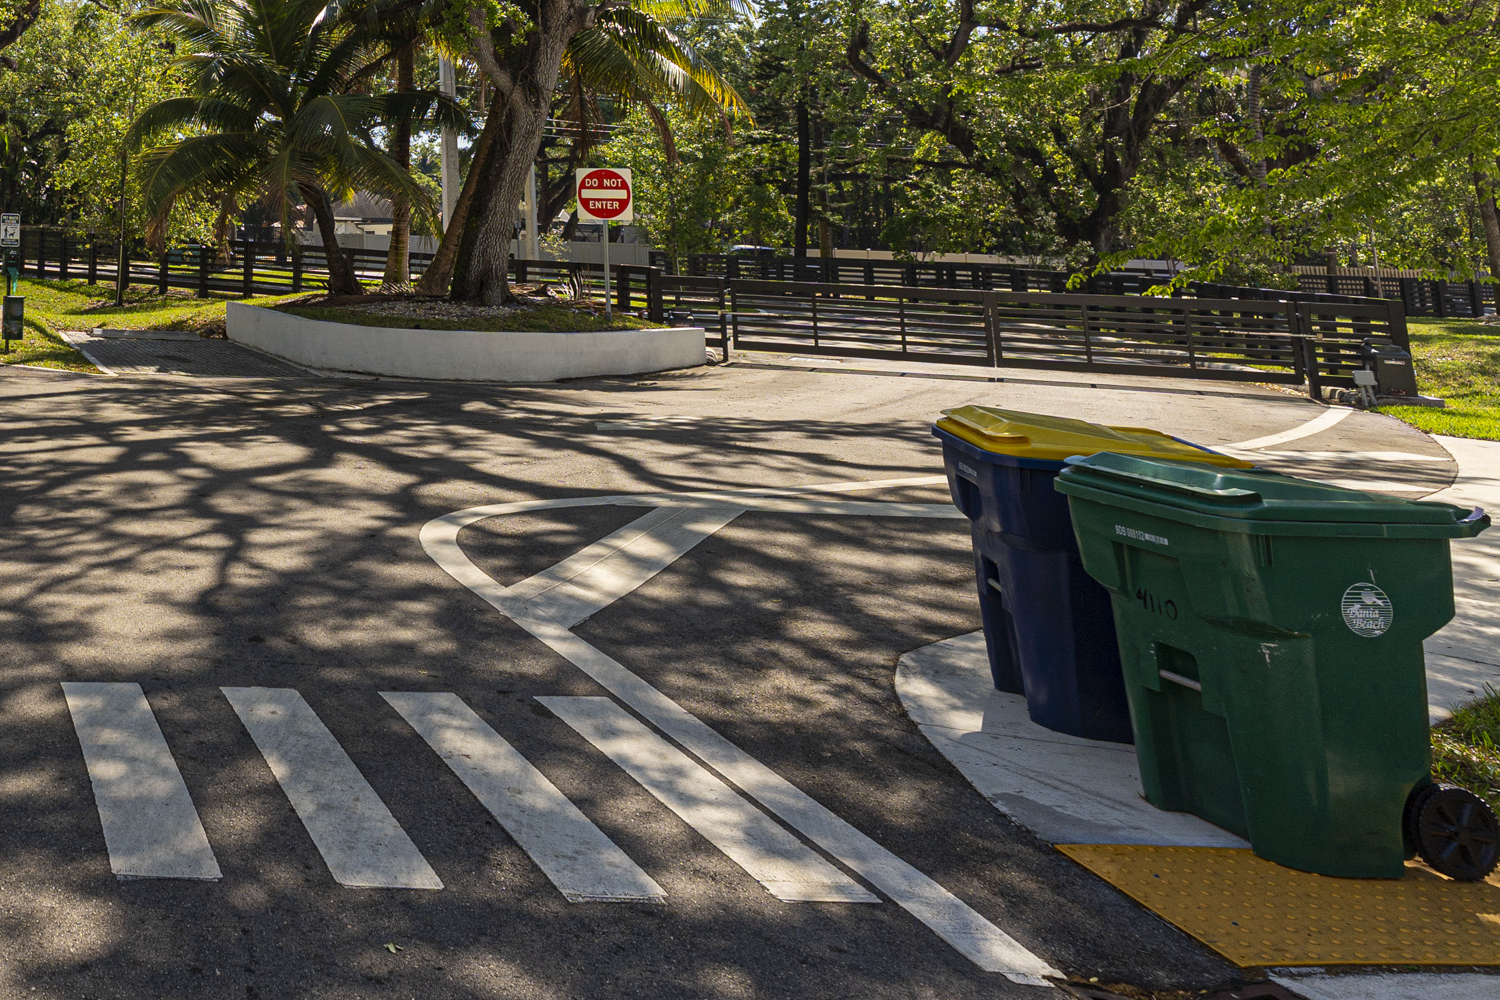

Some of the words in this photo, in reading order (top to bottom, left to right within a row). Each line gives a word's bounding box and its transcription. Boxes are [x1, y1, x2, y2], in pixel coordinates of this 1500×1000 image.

[585, 179, 598, 187] DO
[603, 179, 622, 187] NOT
[589, 201, 619, 209] ENTER
[1136, 588, 1178, 620] 4110
[1347, 606, 1379, 618] Dania
[1353, 617, 1386, 629] Beach
